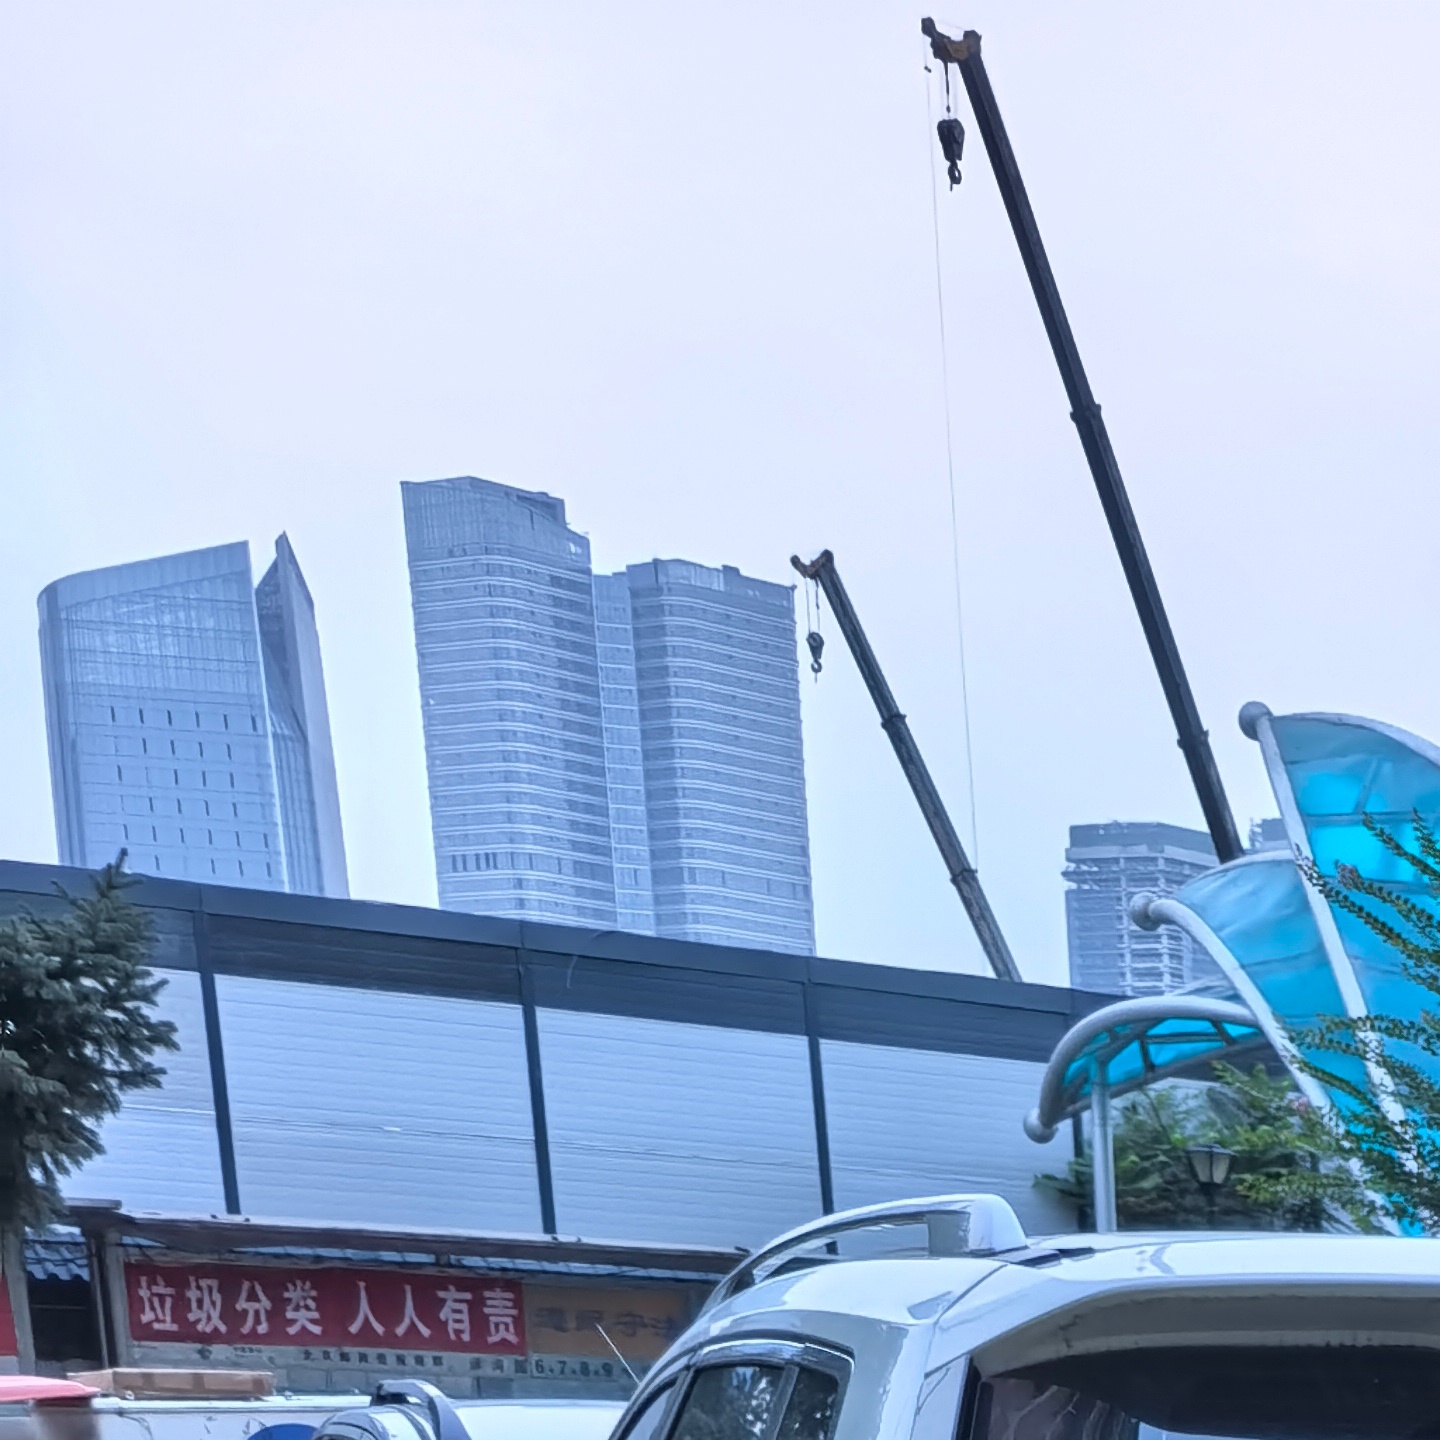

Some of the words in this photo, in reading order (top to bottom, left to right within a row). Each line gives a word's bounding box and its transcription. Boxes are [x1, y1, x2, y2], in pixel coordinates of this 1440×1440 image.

[137, 1275, 323, 1337] 垃圾分类
[347, 1280, 520, 1345] 人人有责
